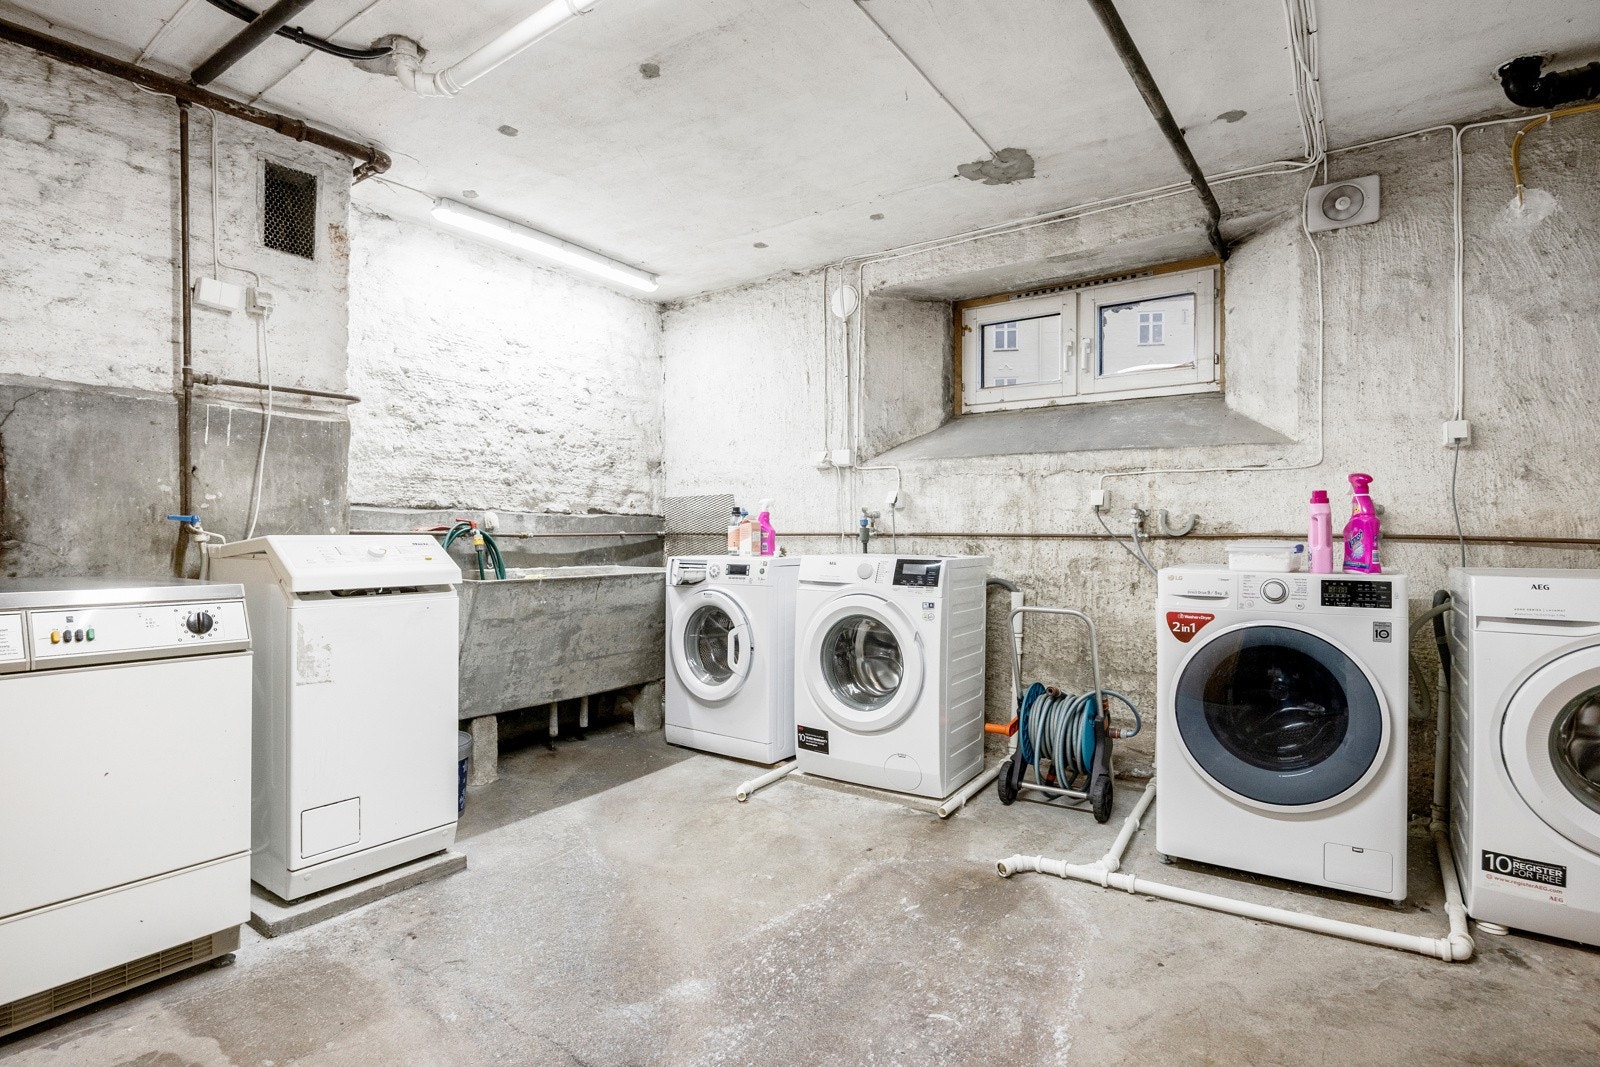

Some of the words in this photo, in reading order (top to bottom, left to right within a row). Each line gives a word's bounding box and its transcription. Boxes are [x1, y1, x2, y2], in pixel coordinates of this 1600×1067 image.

[1374, 629, 1390, 639] 10
[1485, 854, 1512, 873] 10
[1513, 861, 1563, 877] REGISTER
[1513, 869, 1534, 878] FOR
[1536, 872, 1562, 885] FREE
[1494, 876, 1563, 895] www.registerAEG.com
